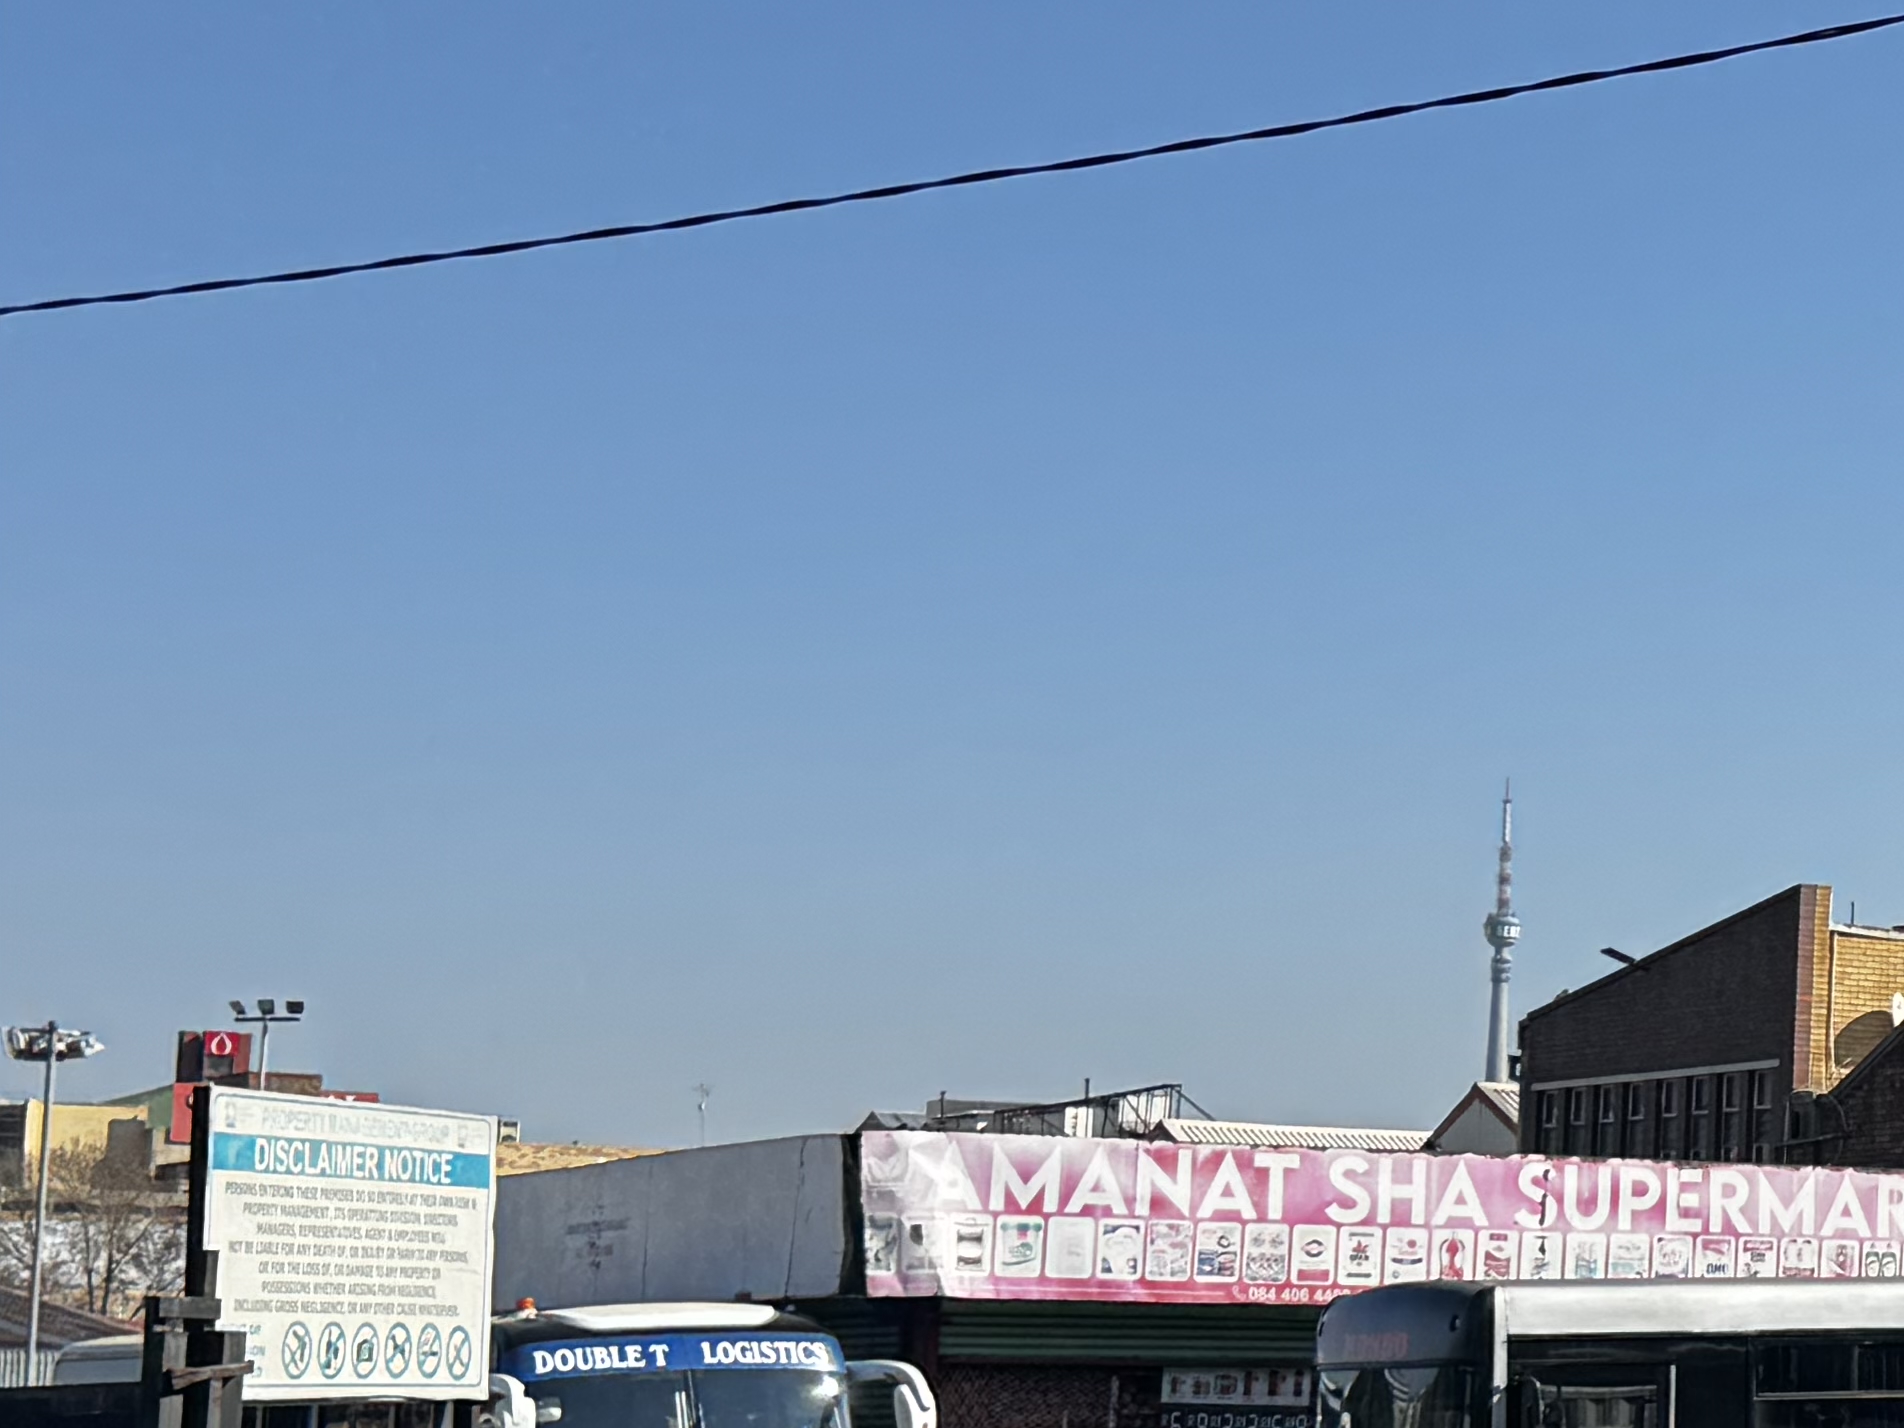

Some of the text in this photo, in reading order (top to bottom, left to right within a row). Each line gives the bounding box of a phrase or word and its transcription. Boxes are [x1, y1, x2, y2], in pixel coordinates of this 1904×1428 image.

[254, 1137, 454, 1184] DISCLAIMER NOTICE
[927, 1139, 1300, 1220] AMANAT
[1325, 1154, 1489, 1227] SHA
[533, 1341, 829, 1374] DOUBLE T LOGISTICS
